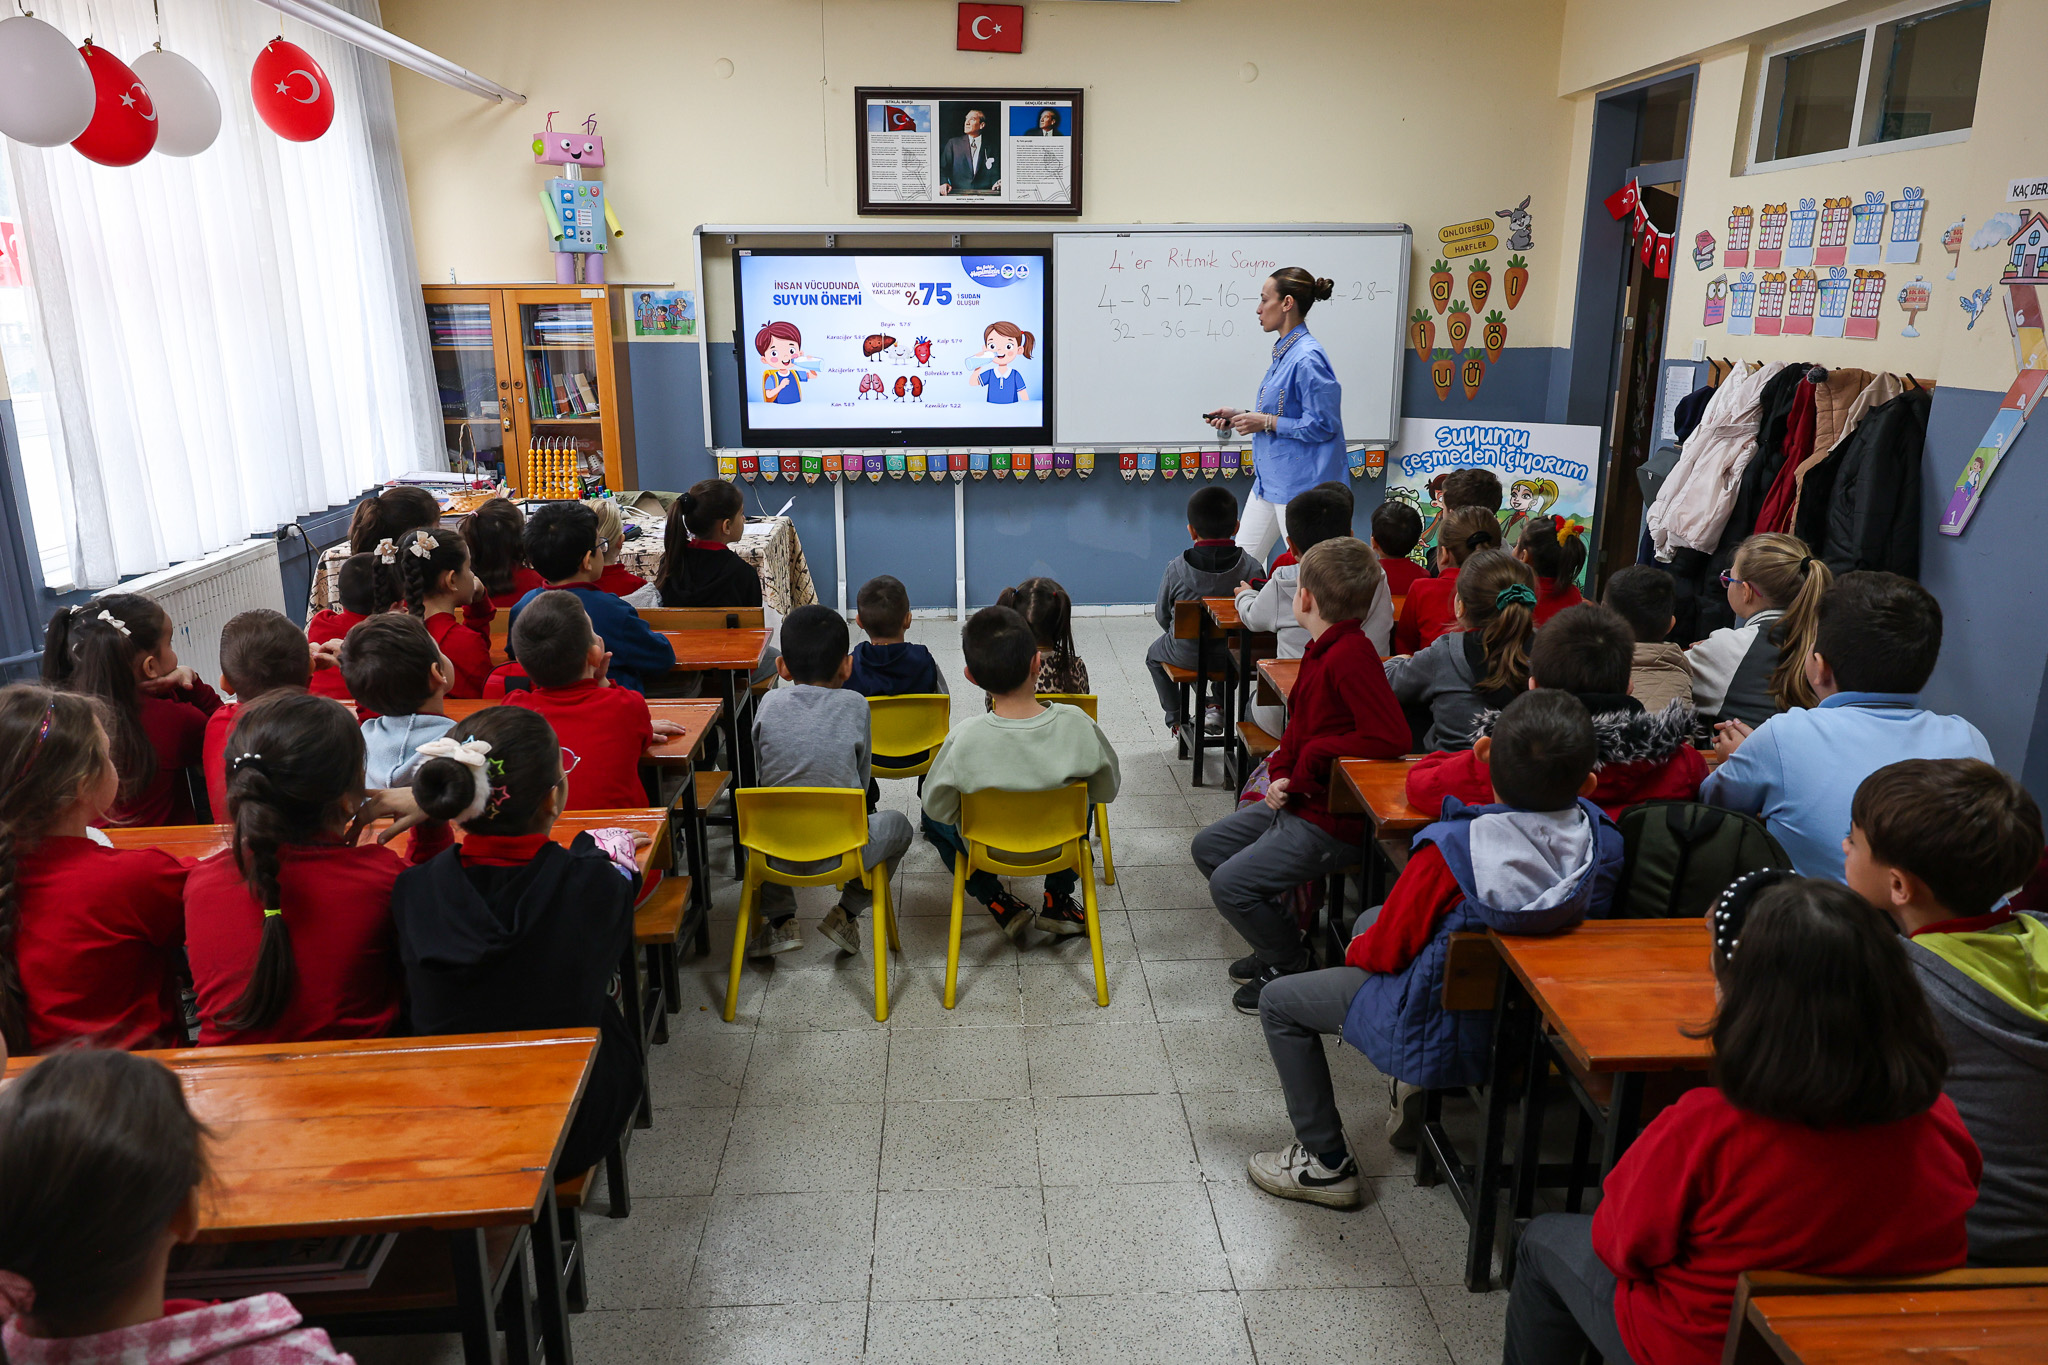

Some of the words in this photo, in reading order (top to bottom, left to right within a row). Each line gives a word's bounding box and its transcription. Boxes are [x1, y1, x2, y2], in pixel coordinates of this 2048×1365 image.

[2012, 184, 2030, 199] KAÇ
[2030, 182, 2048, 196] DER
[1454, 241, 1487, 253] HARFLER
[1167, 248, 1220, 268] Ritmik
[774, 280, 803, 290] İNSAN
[804, 280, 860, 290] VÜCUDUNDA
[1432, 281, 1450, 301] a
[1471, 279, 1488, 300] e
[773, 294, 818, 306] SUYUN
[821, 291, 862, 306] ÖNEMİ
[2015, 309, 2025, 327] 6
[1418, 324, 1428, 350] i
[1451, 321, 1467, 341] o
[1486, 325, 1503, 351] ö
[2025, 353, 2038, 369] 5
[1434, 369, 1451, 388] u
[1463, 362, 1481, 388] ü
[2016, 394, 2027, 410] 4
[1435, 426, 1530, 449] Suyumu
[1994, 433, 2004, 448] 3
[741, 460, 754, 469] Bb
[762, 459, 775, 468] Cc
[804, 460, 818, 469] Dd
[826, 458, 838, 467] Ee
[847, 458, 859, 467] Ff
[866, 459, 881, 471] Gg
[974, 458, 984, 469] Jj
[995, 457, 1006, 466] Kk
[1035, 457, 1052, 466] Mm
[1057, 456, 1070, 465] Nn
[1078, 457, 1092, 465] Oo
[1123, 456, 1134, 468] Pp
[1141, 457, 1152, 465] Rr
[1165, 457, 1175, 466] Ss
[1205, 455, 1216, 464] Tt
[1223, 455, 1237, 464] Uu
[1351, 454, 1363, 464] Yy
[1368, 454, 1381, 463] Zz
[1401, 445, 1498, 476] çeşmeden
[1948, 510, 1957, 525] 1
